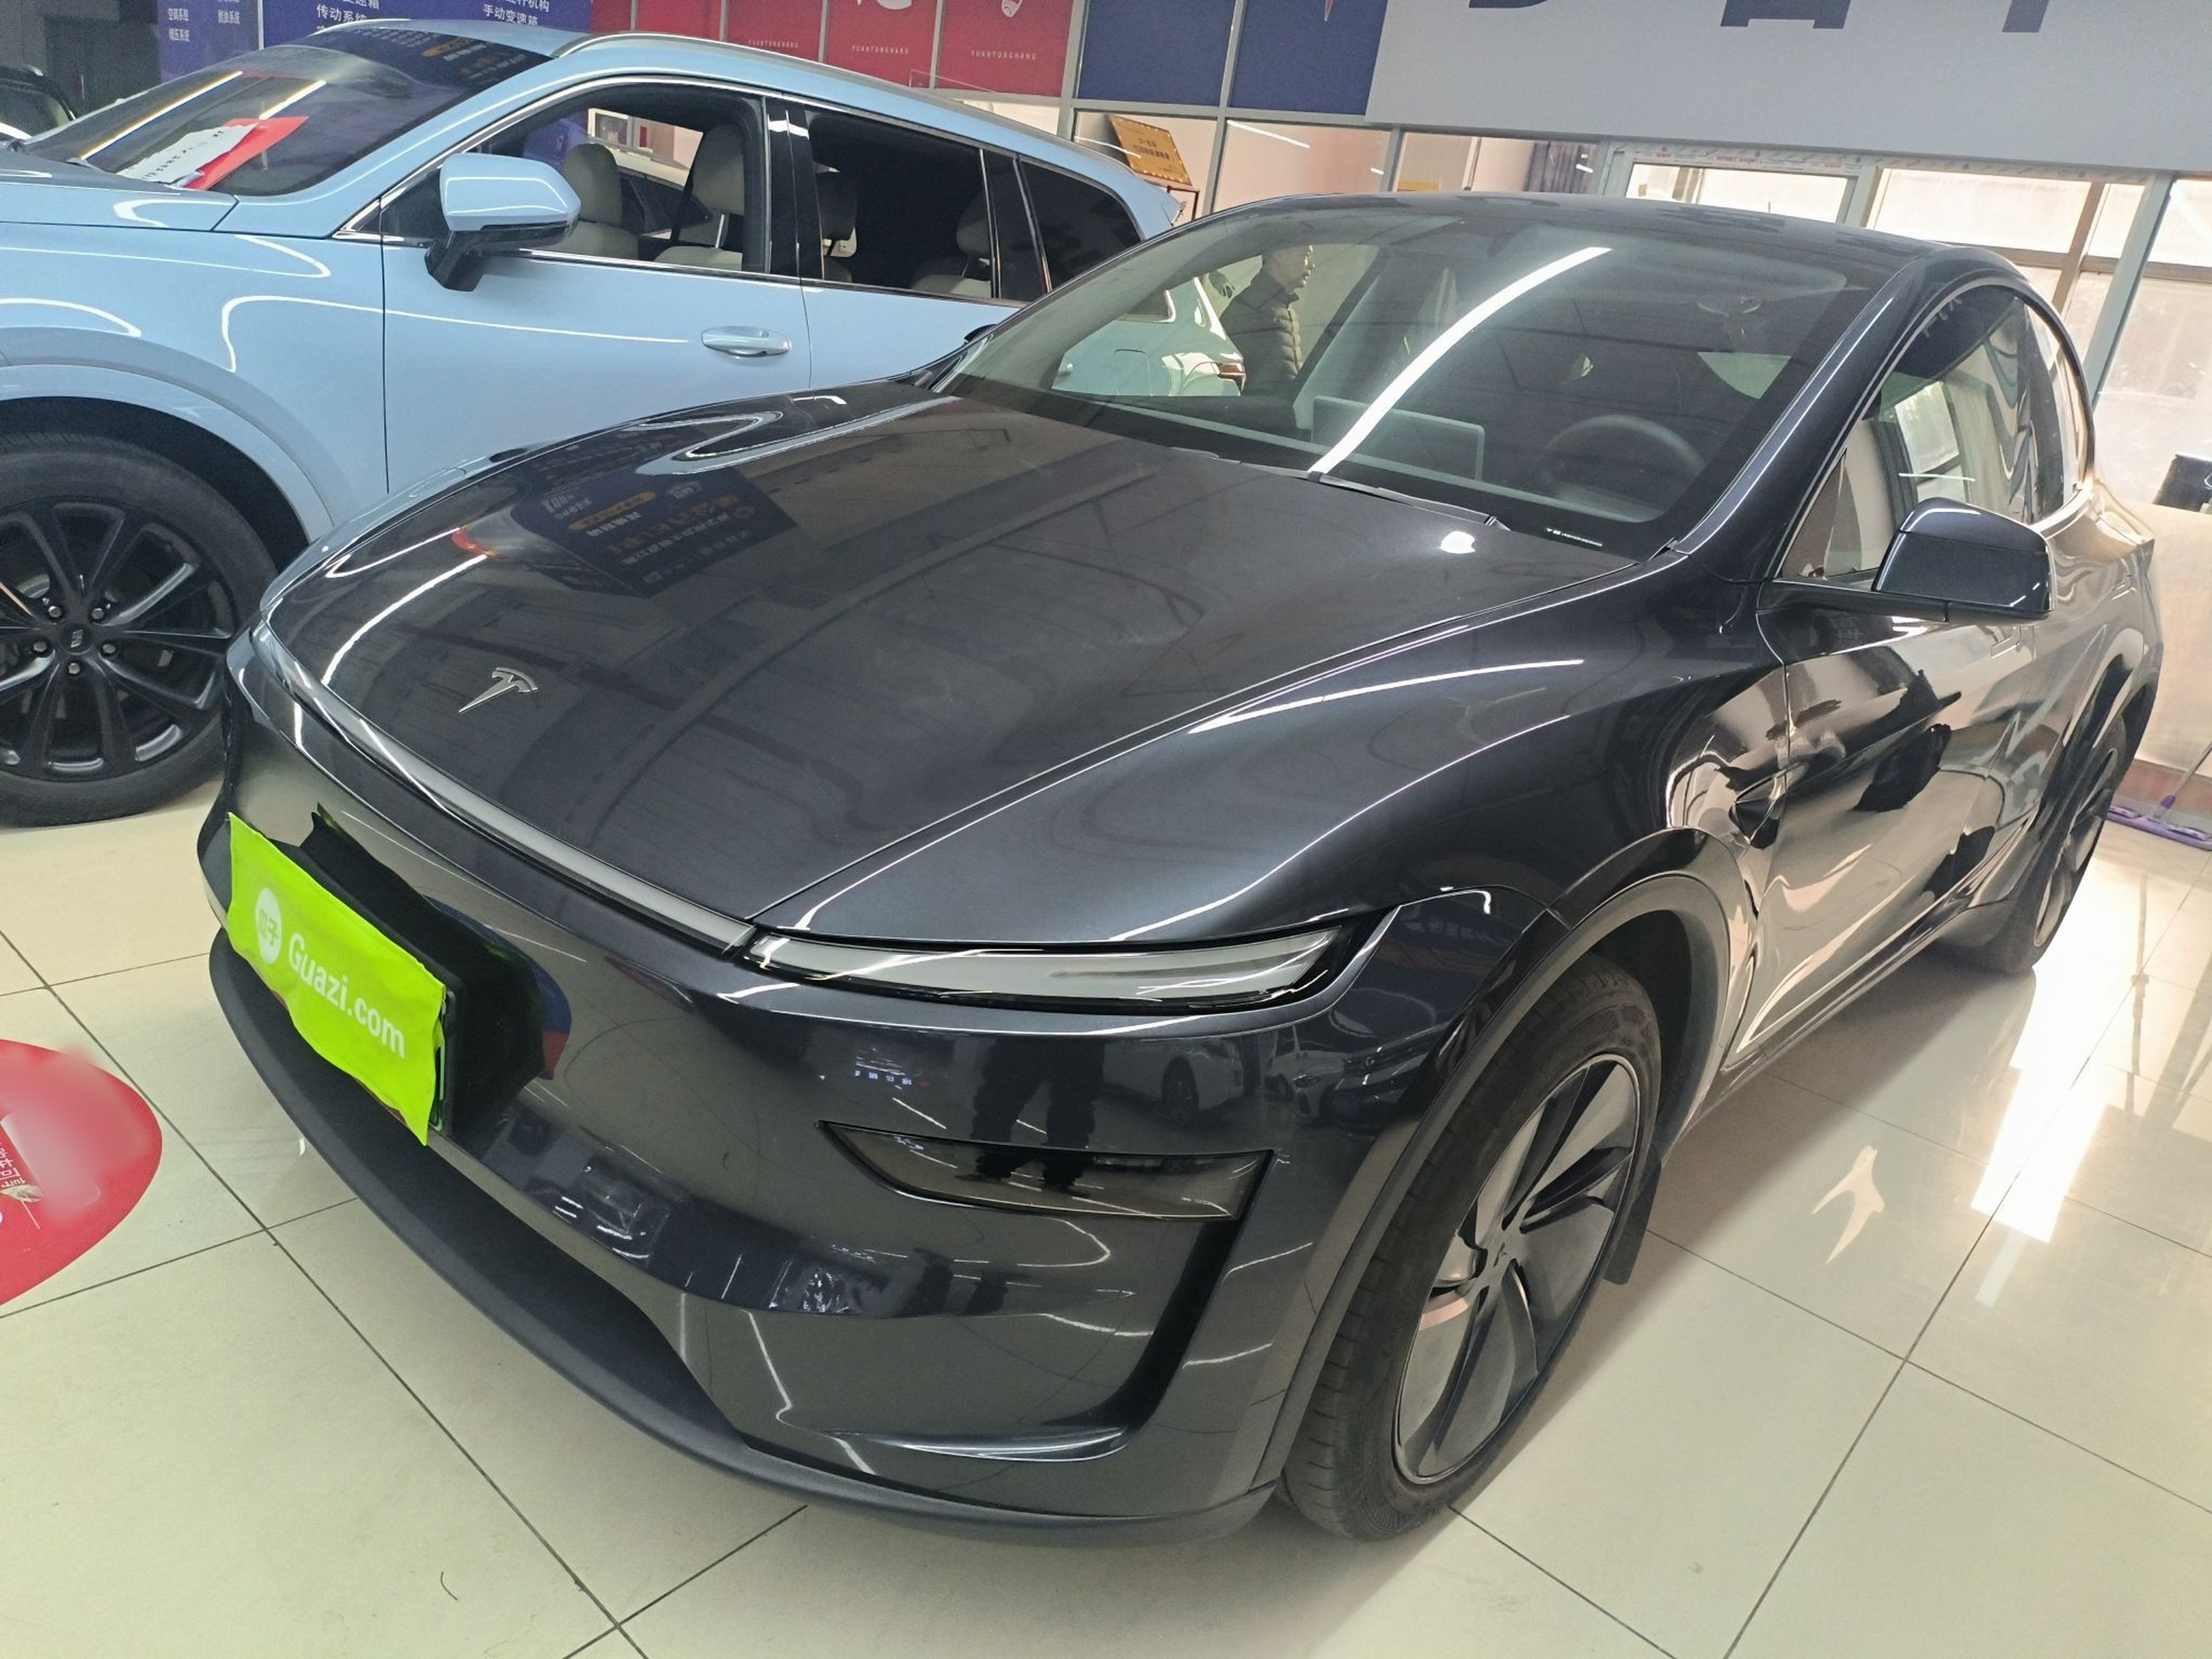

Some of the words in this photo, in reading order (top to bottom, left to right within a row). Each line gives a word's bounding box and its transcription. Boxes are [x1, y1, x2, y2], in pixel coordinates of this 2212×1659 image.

[484, 3, 539, 25] 手动变速箱
[289, 933, 406, 1059] Guazi.com
